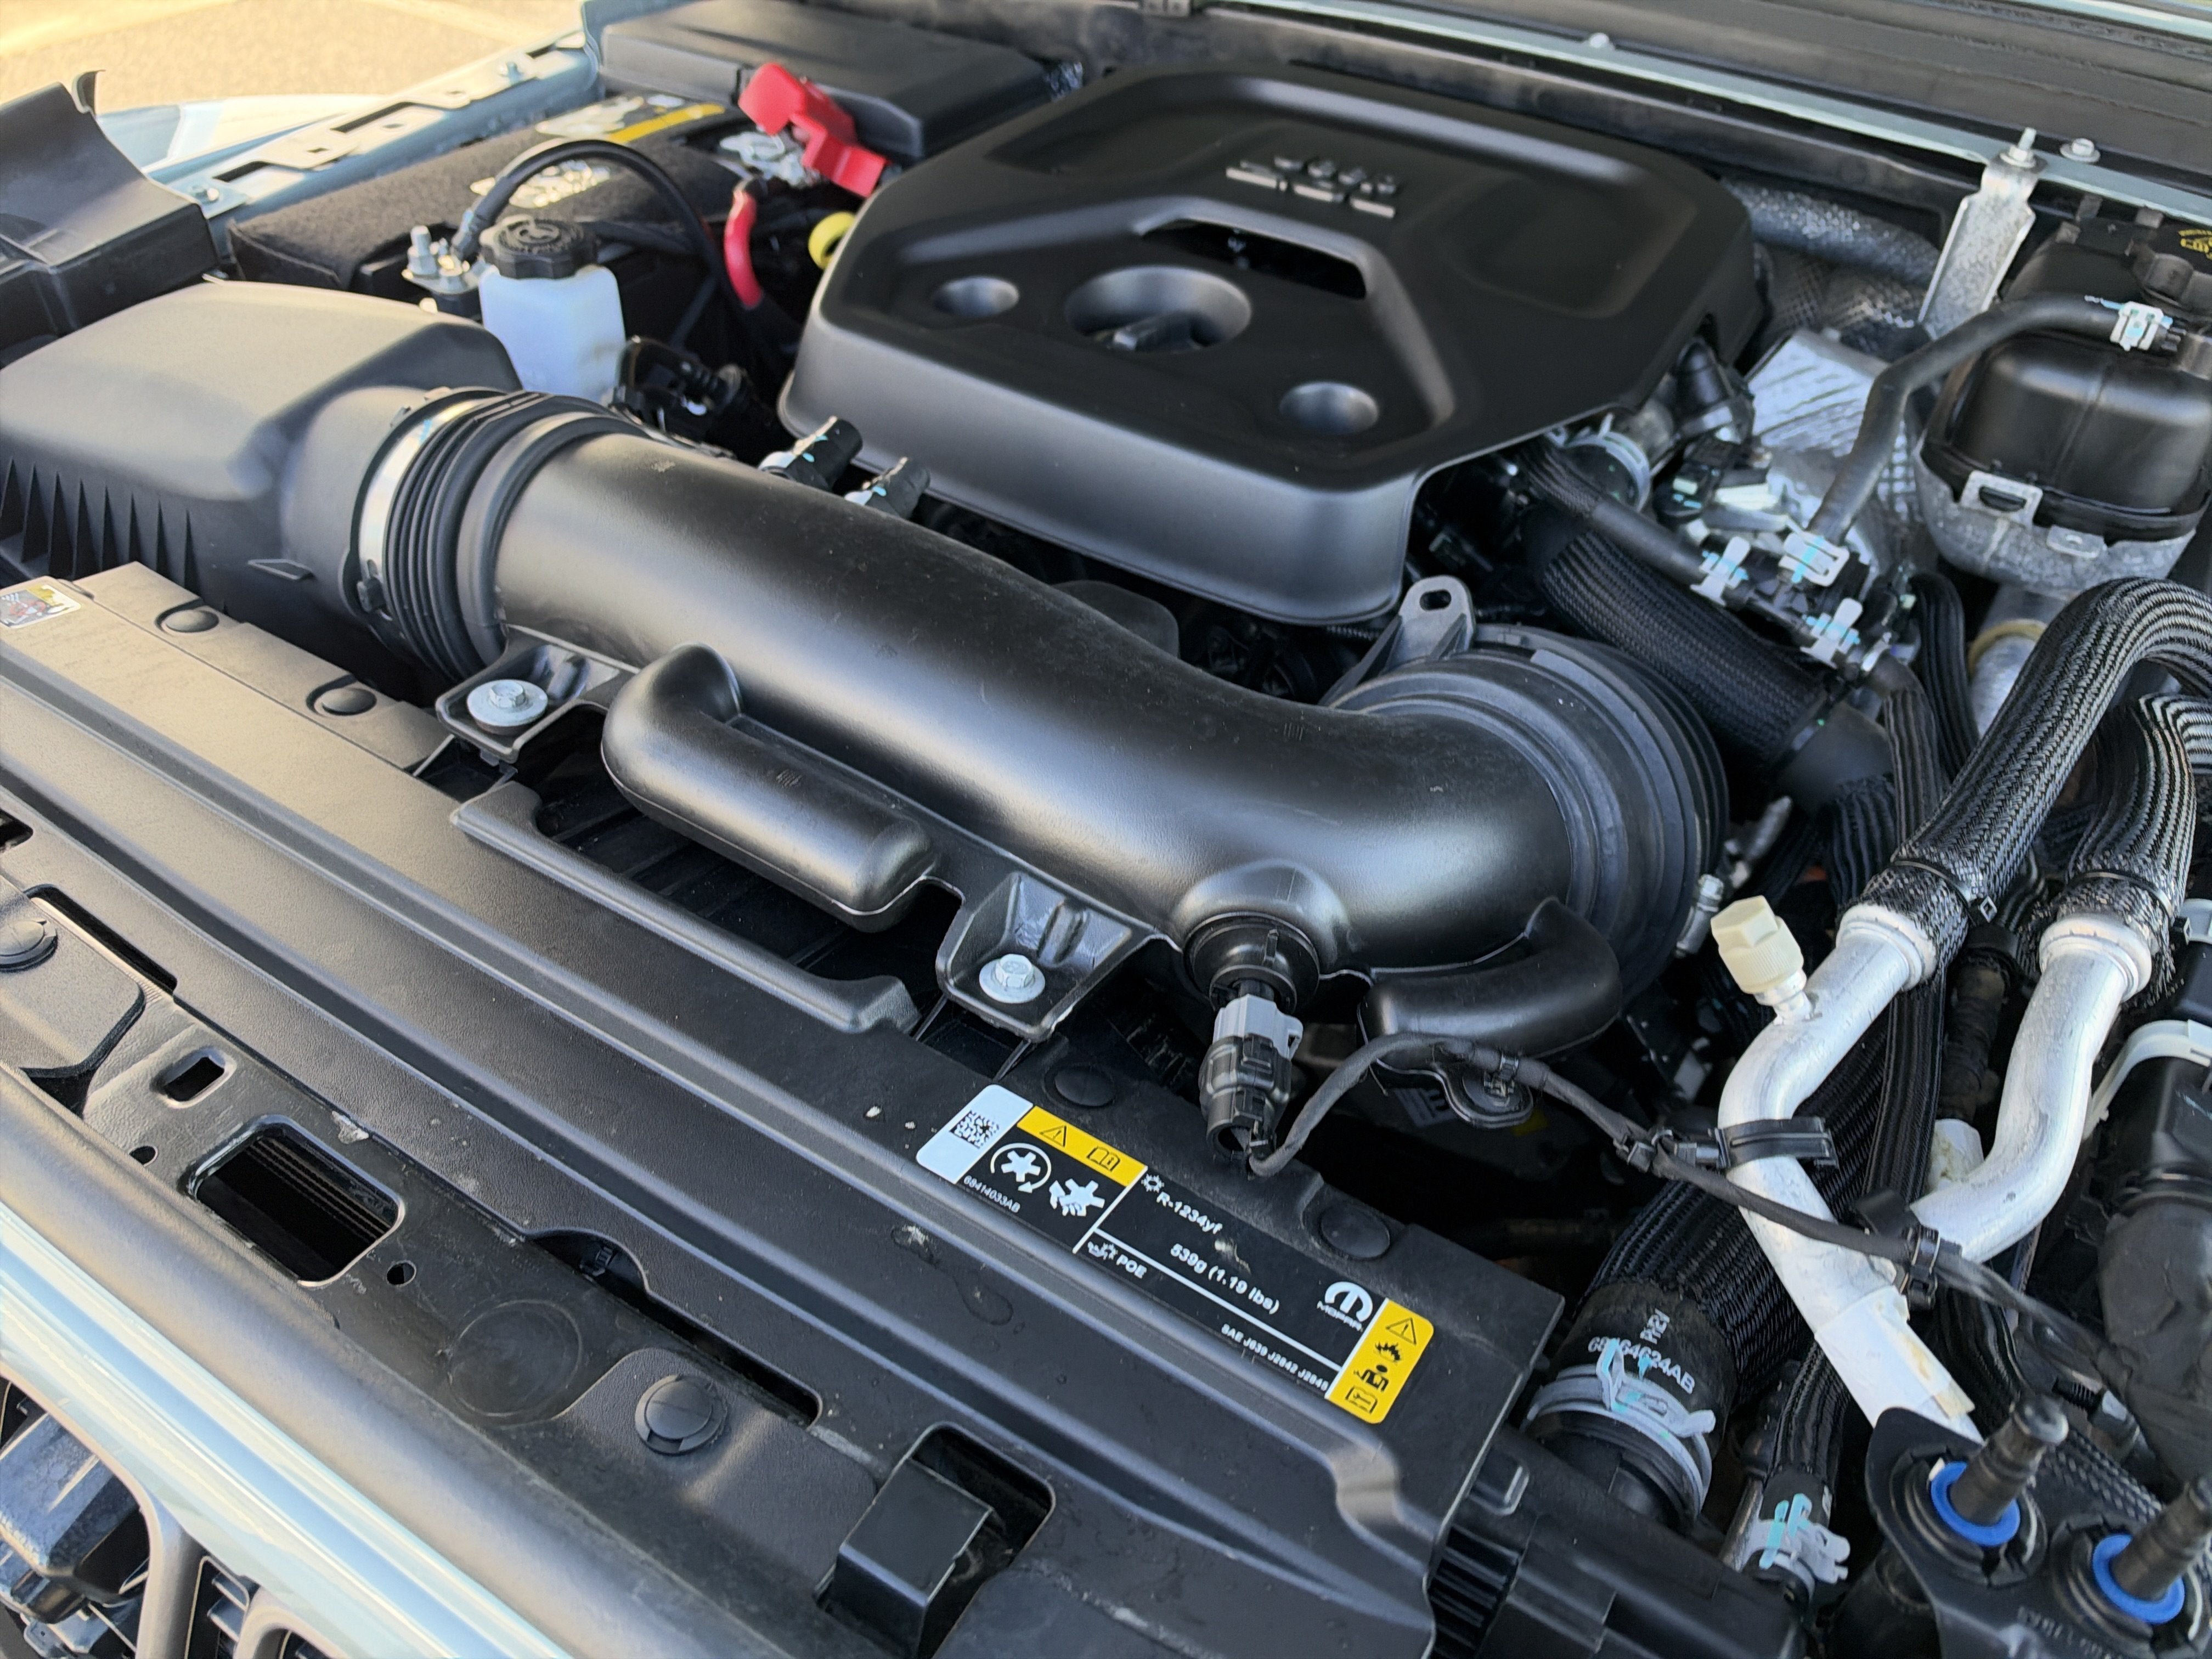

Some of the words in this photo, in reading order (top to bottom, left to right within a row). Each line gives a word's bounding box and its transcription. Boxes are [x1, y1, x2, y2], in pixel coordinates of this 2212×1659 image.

[1156, 1191, 1223, 1234] R-1234yf
[1116, 1254, 1147, 1279] POE
[1170, 1243, 1207, 1274] 539g
[1208, 1265, 1248, 1294] (1.19
[1248, 1286, 1279, 1314] lbs)
